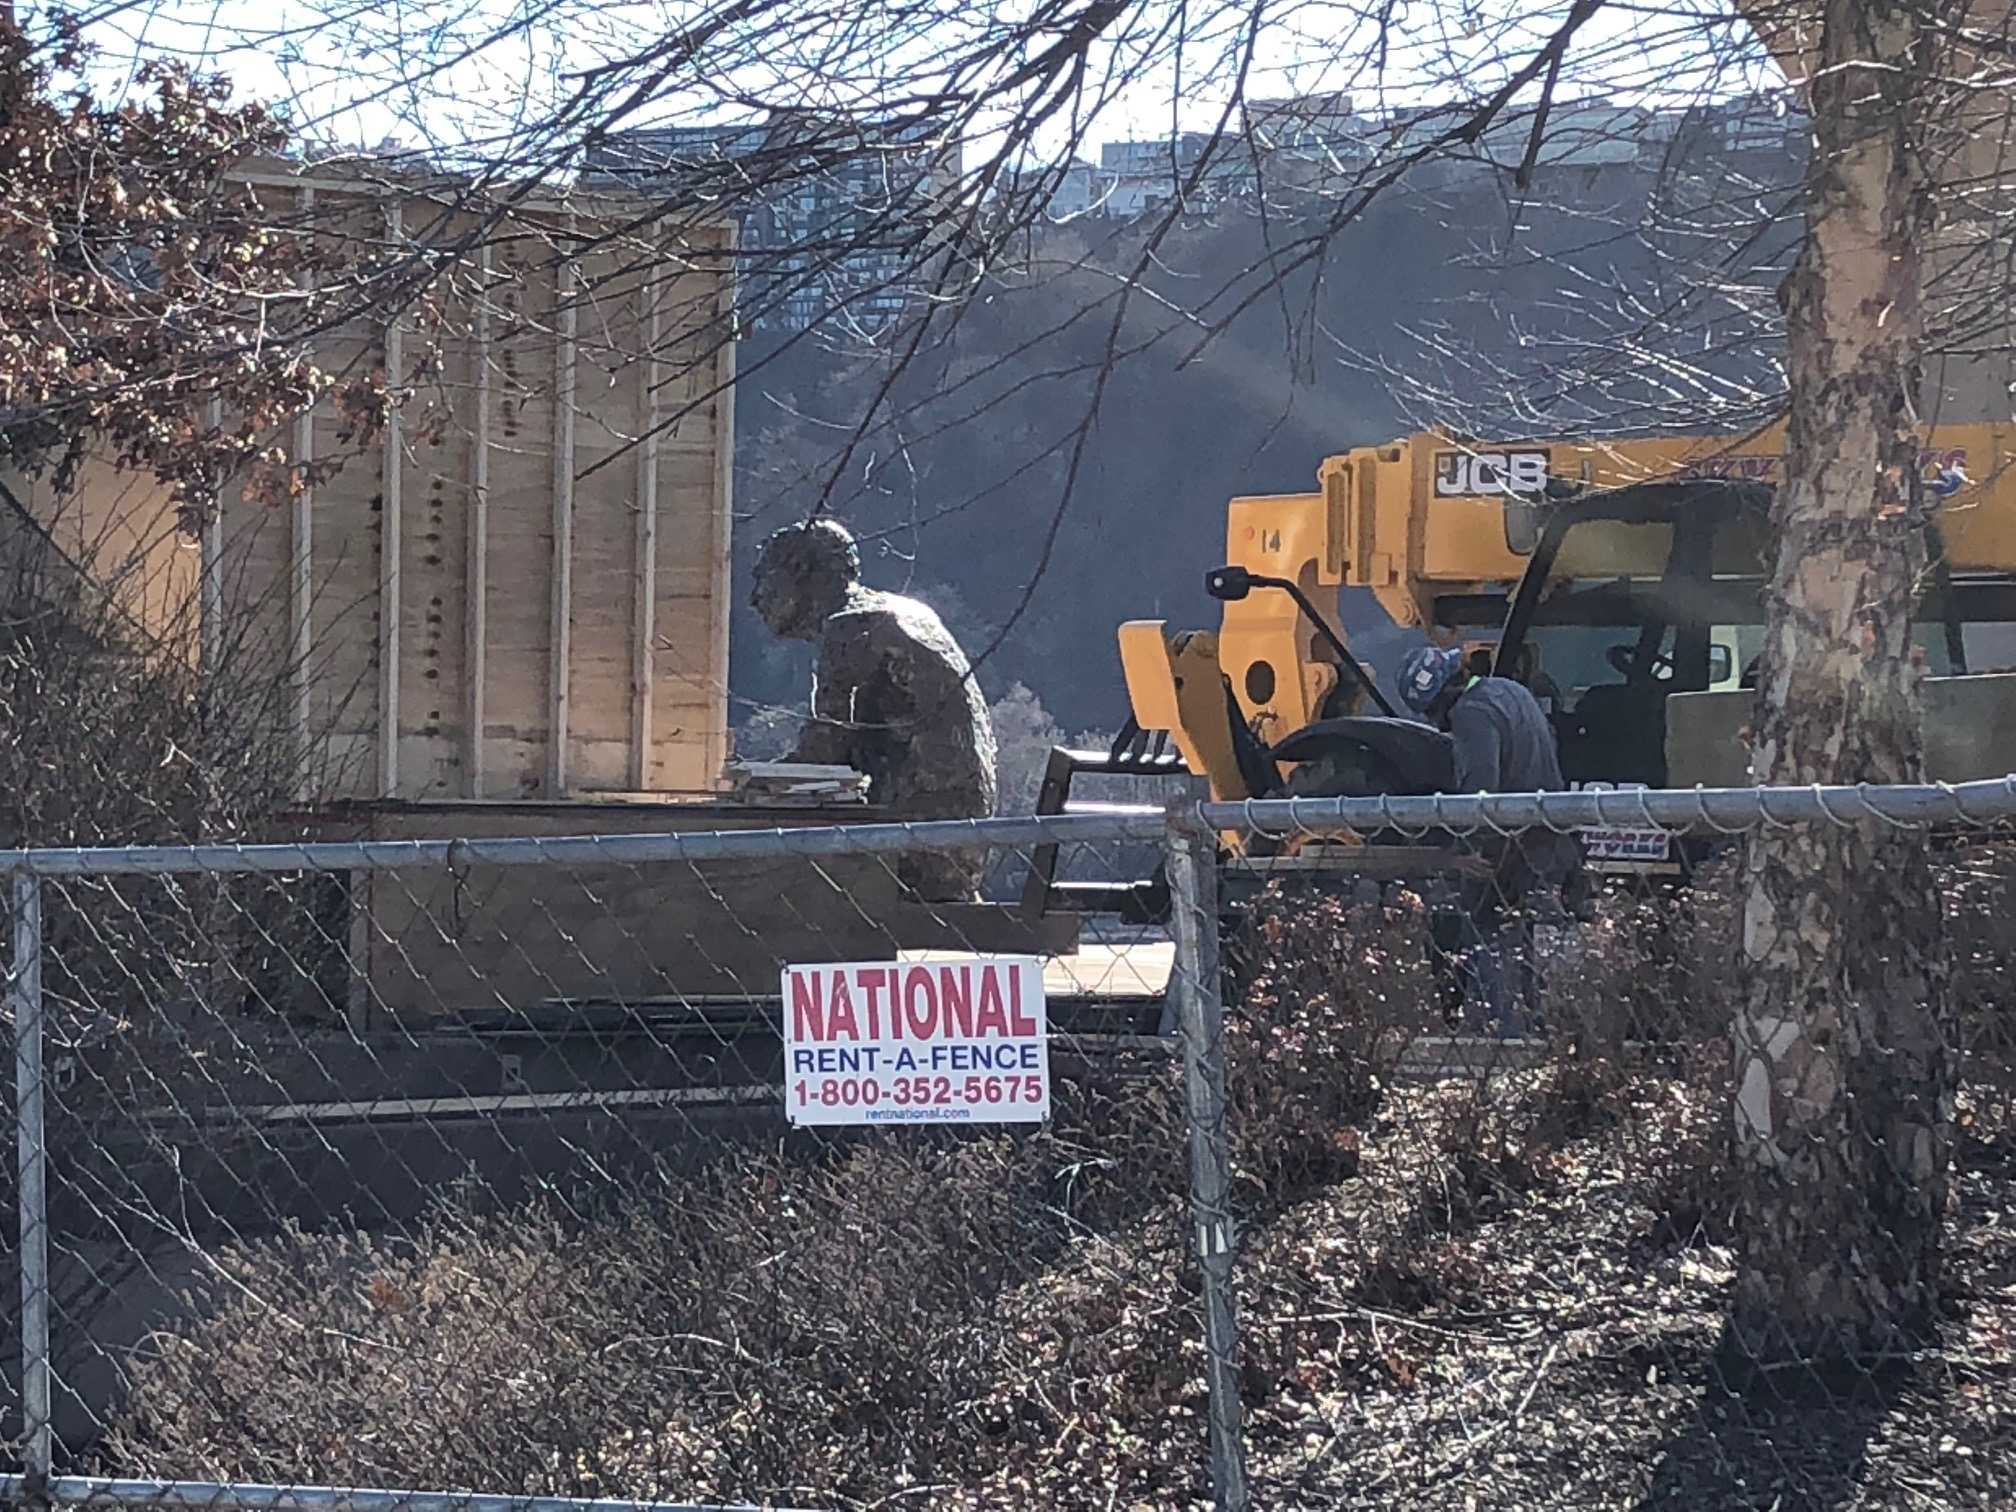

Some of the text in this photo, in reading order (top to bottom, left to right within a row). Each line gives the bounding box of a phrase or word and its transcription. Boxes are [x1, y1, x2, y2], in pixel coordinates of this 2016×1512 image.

[1437, 453, 1547, 494] JCB
[1262, 529, 1281, 554] 14
[791, 964, 1037, 1042] NATIONAL
[794, 1044, 1040, 1073] RENT-A-FENCE
[795, 1075, 1042, 1106] 1-800-352-5675
[865, 1107, 970, 1120] rentnational.com
